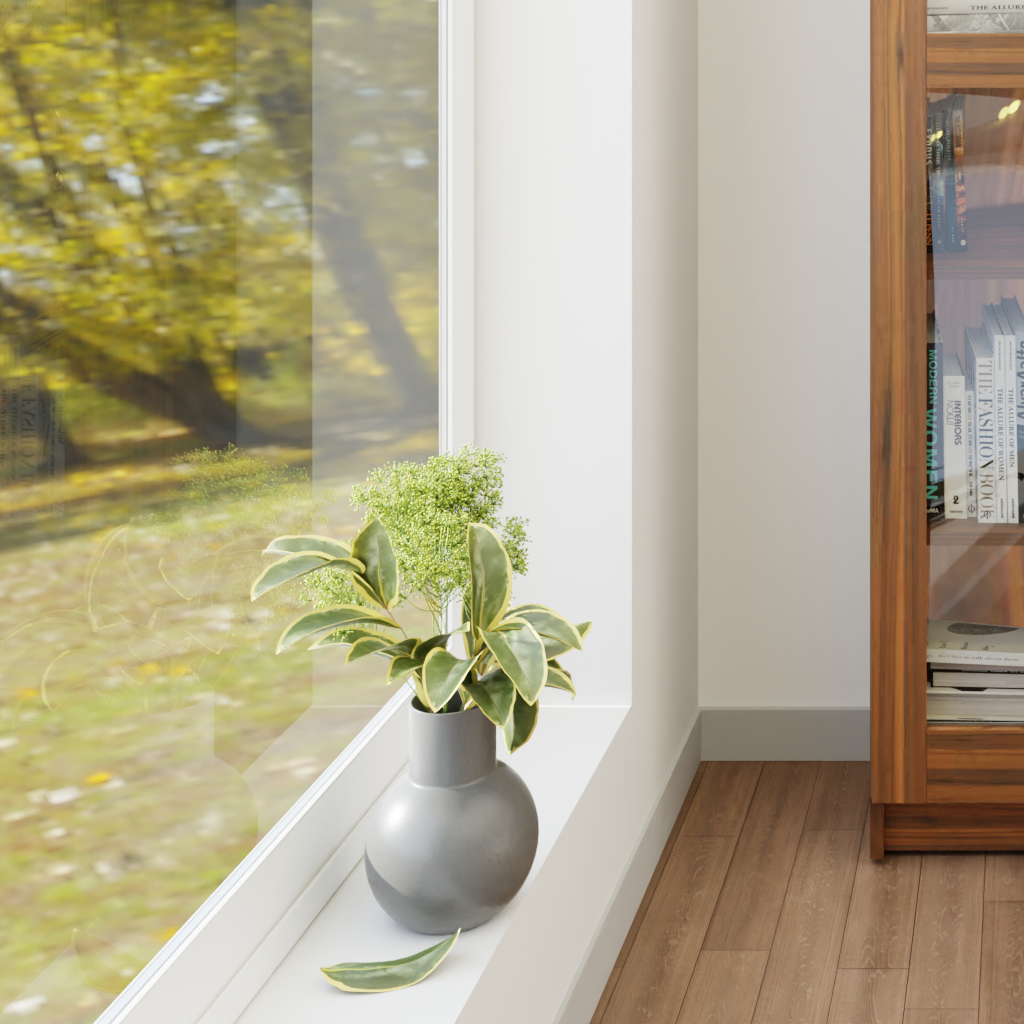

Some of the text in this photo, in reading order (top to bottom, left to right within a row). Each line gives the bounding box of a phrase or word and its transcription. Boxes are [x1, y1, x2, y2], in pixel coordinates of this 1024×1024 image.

[929, 350, 937, 404] MODERN
[978, 360, 994, 520] THE FASHION BOOK
[998, 438, 1004, 449] OF
[1009, 438, 1014, 449] OF
[953, 495, 959, 504] 2
